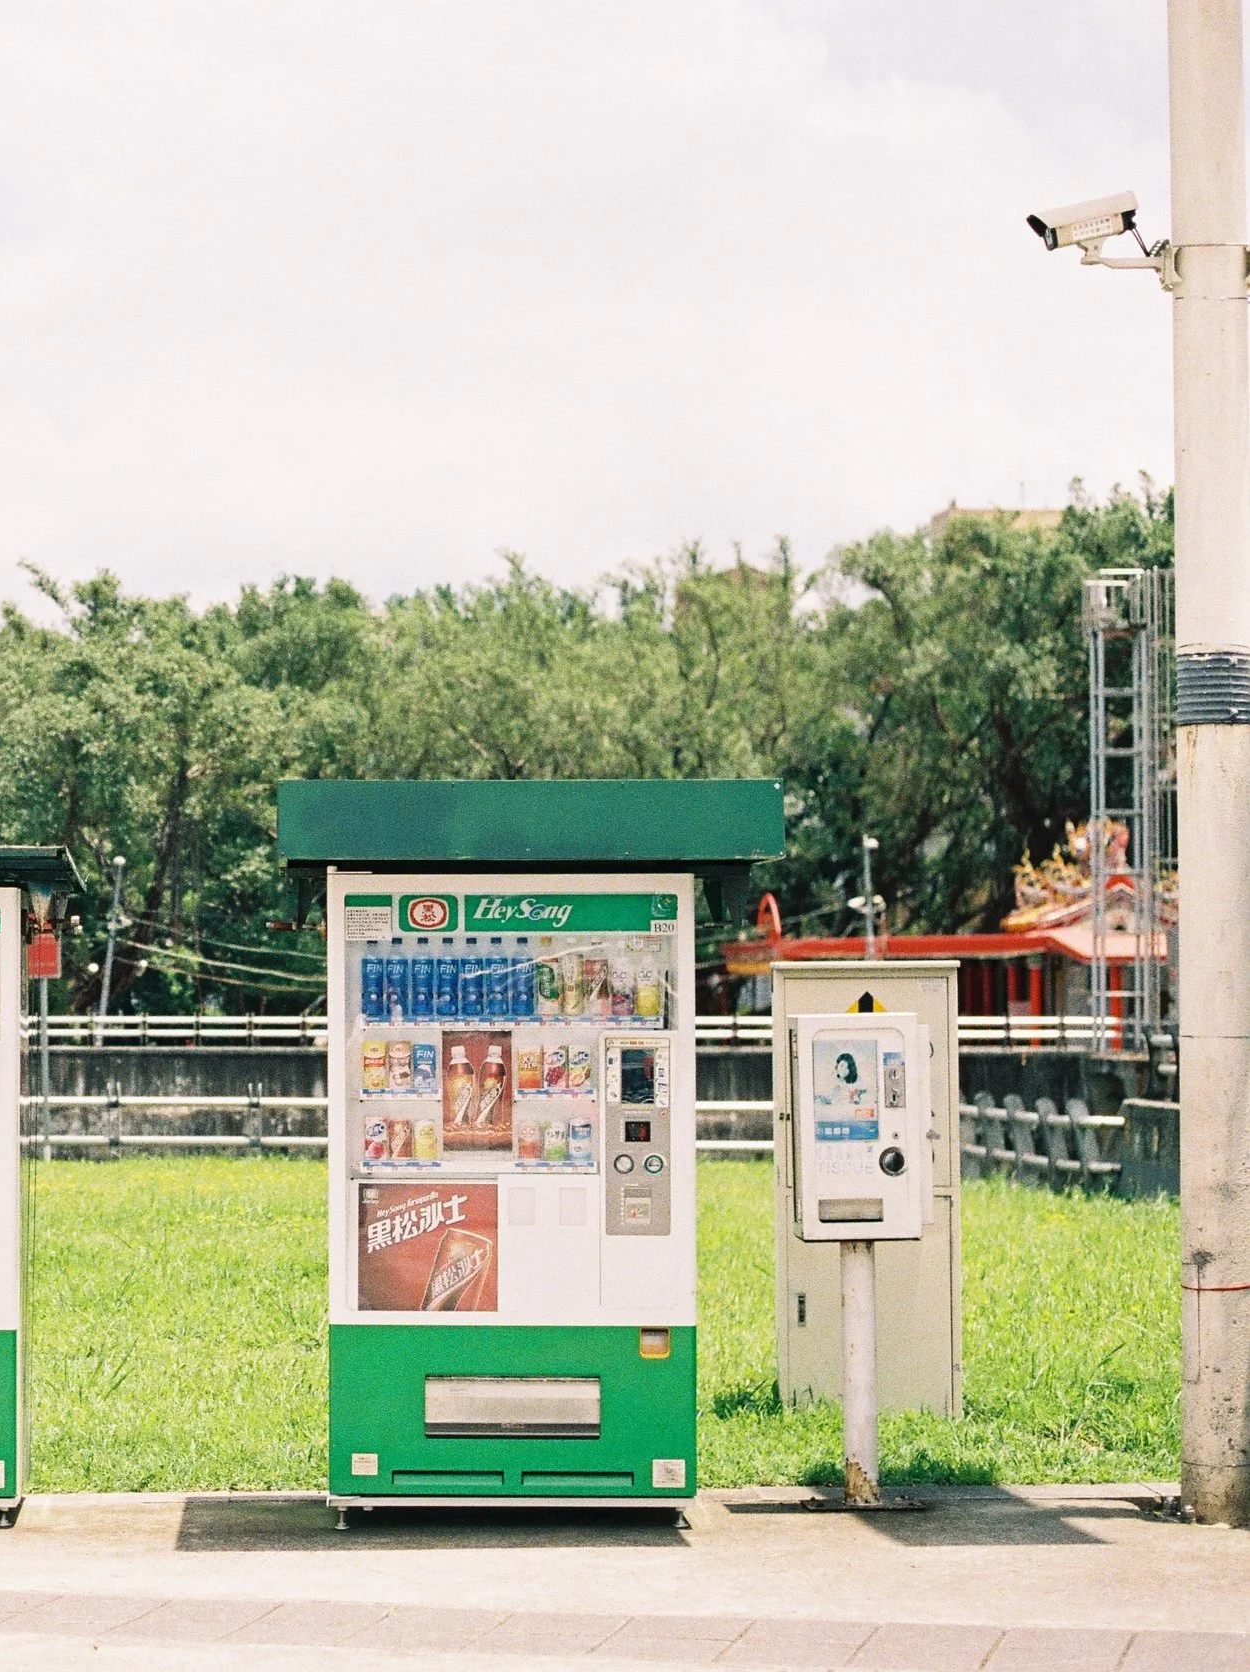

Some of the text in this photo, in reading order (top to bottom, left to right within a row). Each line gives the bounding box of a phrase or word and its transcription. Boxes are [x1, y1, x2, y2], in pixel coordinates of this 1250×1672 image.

[654, 923, 675, 932] B20
[366, 963, 382, 973] FIN
[387, 963, 404, 973] FIN
[414, 963, 431, 973] FIN
[439, 963, 456, 973] FIN
[416, 1050, 434, 1059] FIN
[367, 1194, 468, 1254] 黑松沙士
